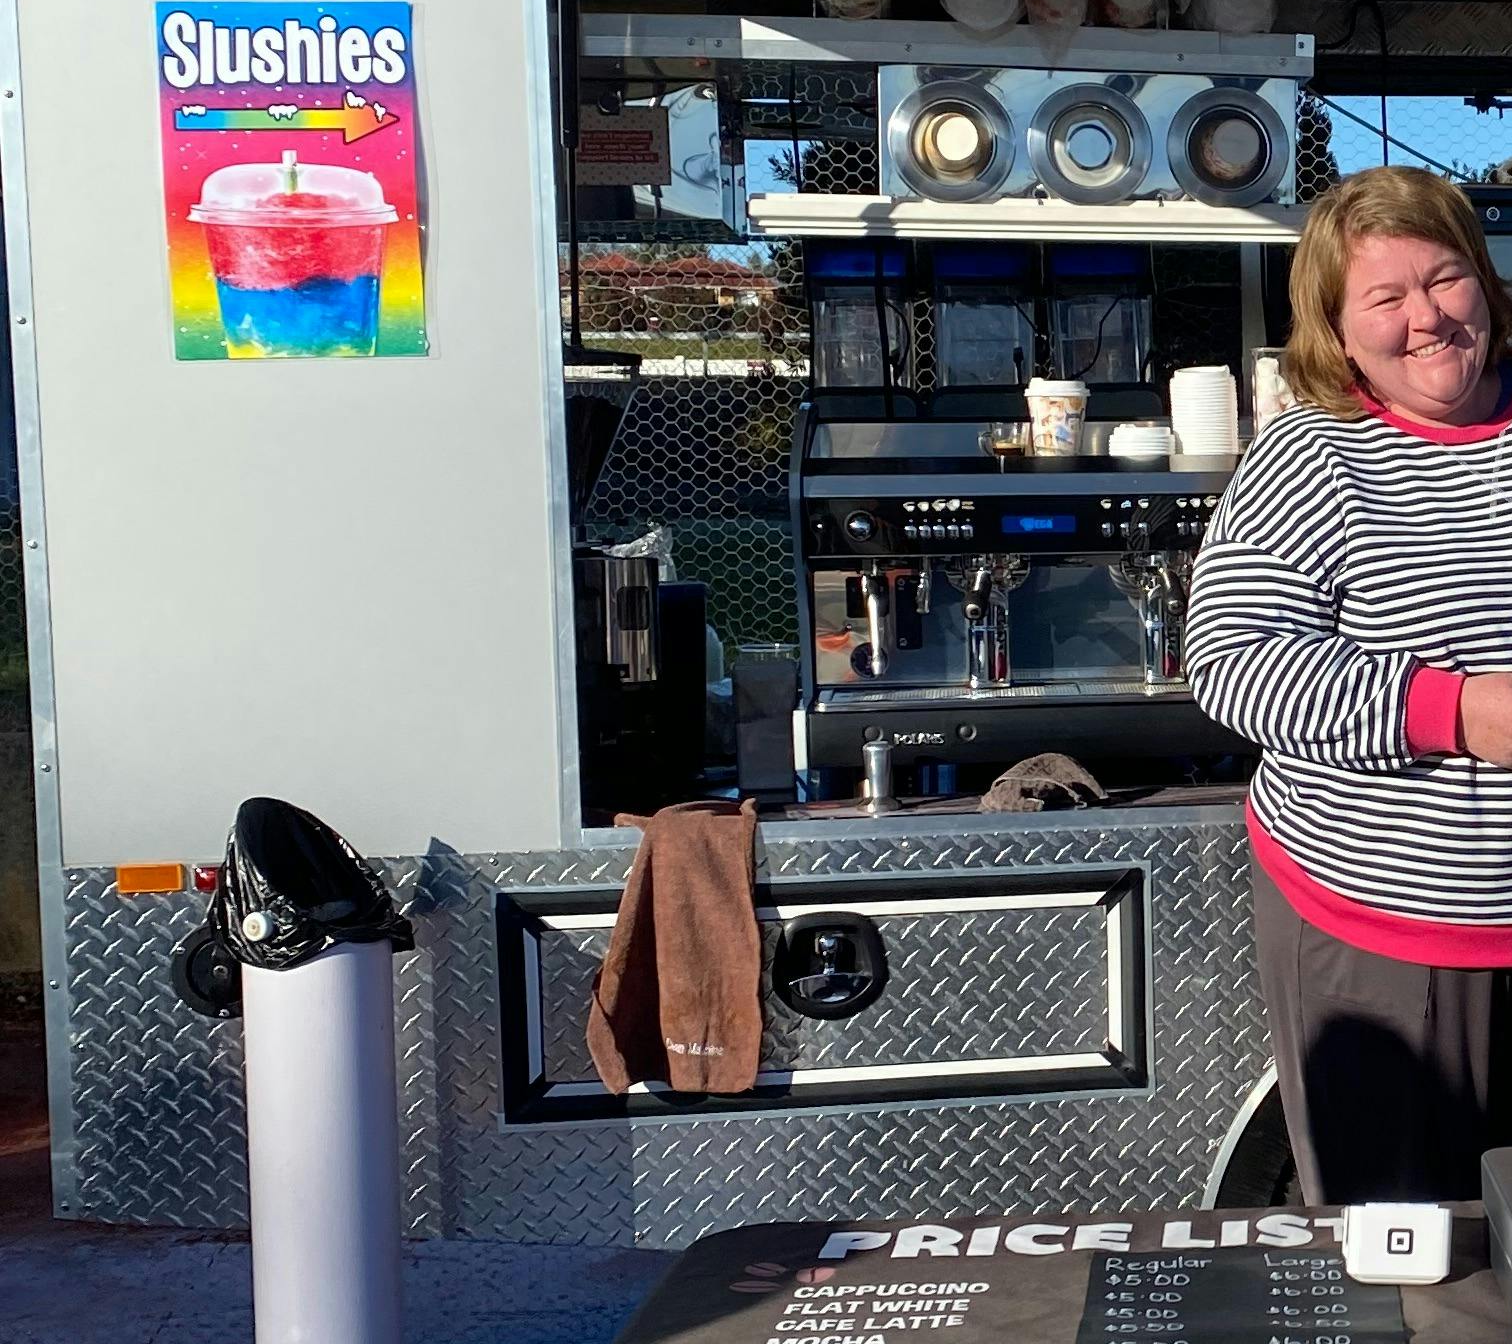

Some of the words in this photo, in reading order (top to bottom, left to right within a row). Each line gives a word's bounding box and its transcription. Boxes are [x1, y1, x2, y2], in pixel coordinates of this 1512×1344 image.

[161, 10, 406, 89] Slushies
[818, 1222, 1131, 1258] PRICE
[1161, 1213, 1345, 1250] LIST
[1105, 1256, 1213, 1274] Regular
[1263, 1253, 1344, 1270] Large
[793, 1283, 990, 1301] CAPPUCCINO
[783, 1300, 865, 1315] FLAT
[872, 1298, 971, 1313] WHITE
[774, 1318, 856, 1332] CAFE
[863, 1314, 966, 1331] LATTE
